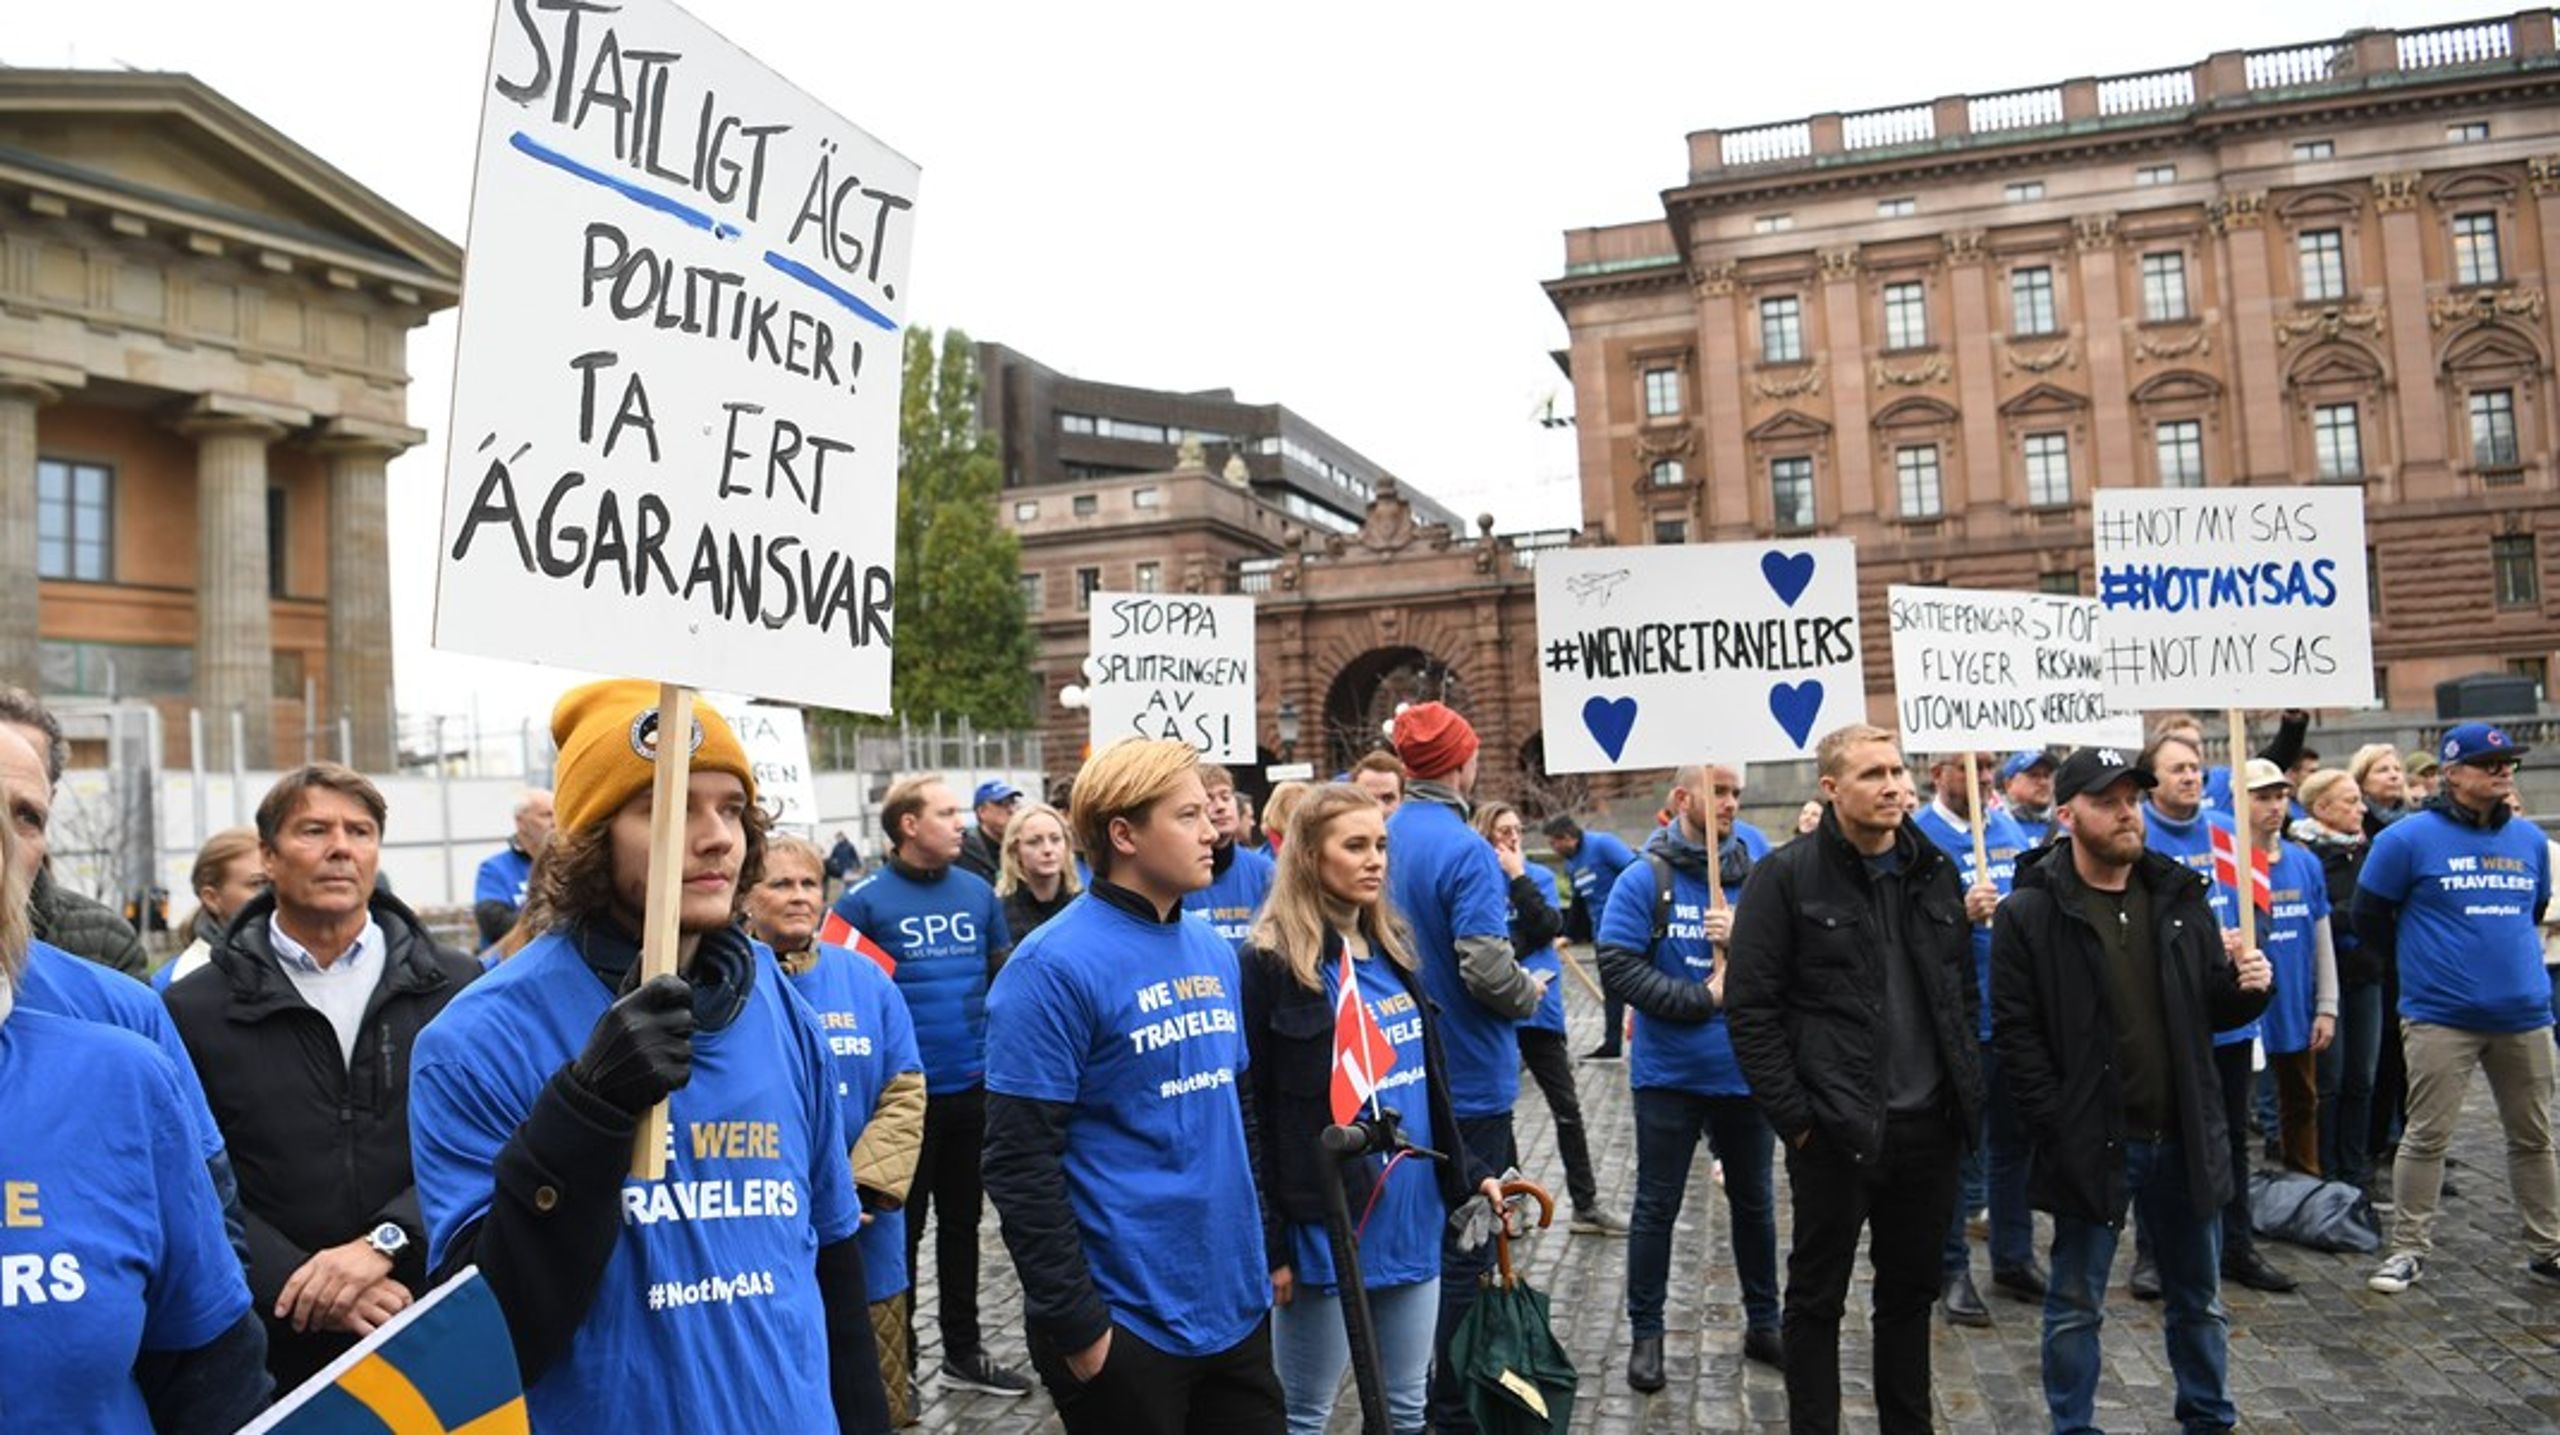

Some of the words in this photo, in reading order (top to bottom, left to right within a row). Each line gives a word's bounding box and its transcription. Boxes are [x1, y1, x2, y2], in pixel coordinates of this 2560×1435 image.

[495, 0, 793, 221] STATLIGT
[788, 137, 912, 301] ÄGT.
[583, 222, 863, 394] POLITIKER!
[571, 351, 661, 462] TA
[718, 402, 855, 515] ERT
[2100, 505, 2188, 552] #NOT
[2196, 503, 2238, 545] MY
[2250, 501, 2318, 544] SAS
[2100, 559, 2337, 613] #NOTMYSAS
[1110, 600, 1216, 638] STOPPA
[1891, 598, 2028, 636] SKATTEPENGAR
[1546, 616, 1855, 680] #WEWERETRAVELERS
[1921, 648, 2018, 687] FLYGER
[2104, 636, 2202, 686] #NOT
[2211, 632, 2259, 680] MY
[2267, 633, 2338, 677] SAS
[1147, 690, 1195, 712] AV
[1903, 695, 2036, 734] UTOMLANDS
[1133, 712, 1231, 756] SAS!
[2448, 855, 2477, 871] WE
[900, 912, 976, 948] SPG
[1136, 982, 1173, 1013] WE
[1173, 976, 1226, 1001] WERE
[690, 1121, 780, 1160] WERE
[621, 1179, 798, 1225] RAVELERS
[648, 1271, 774, 1310] #NotMySAS
